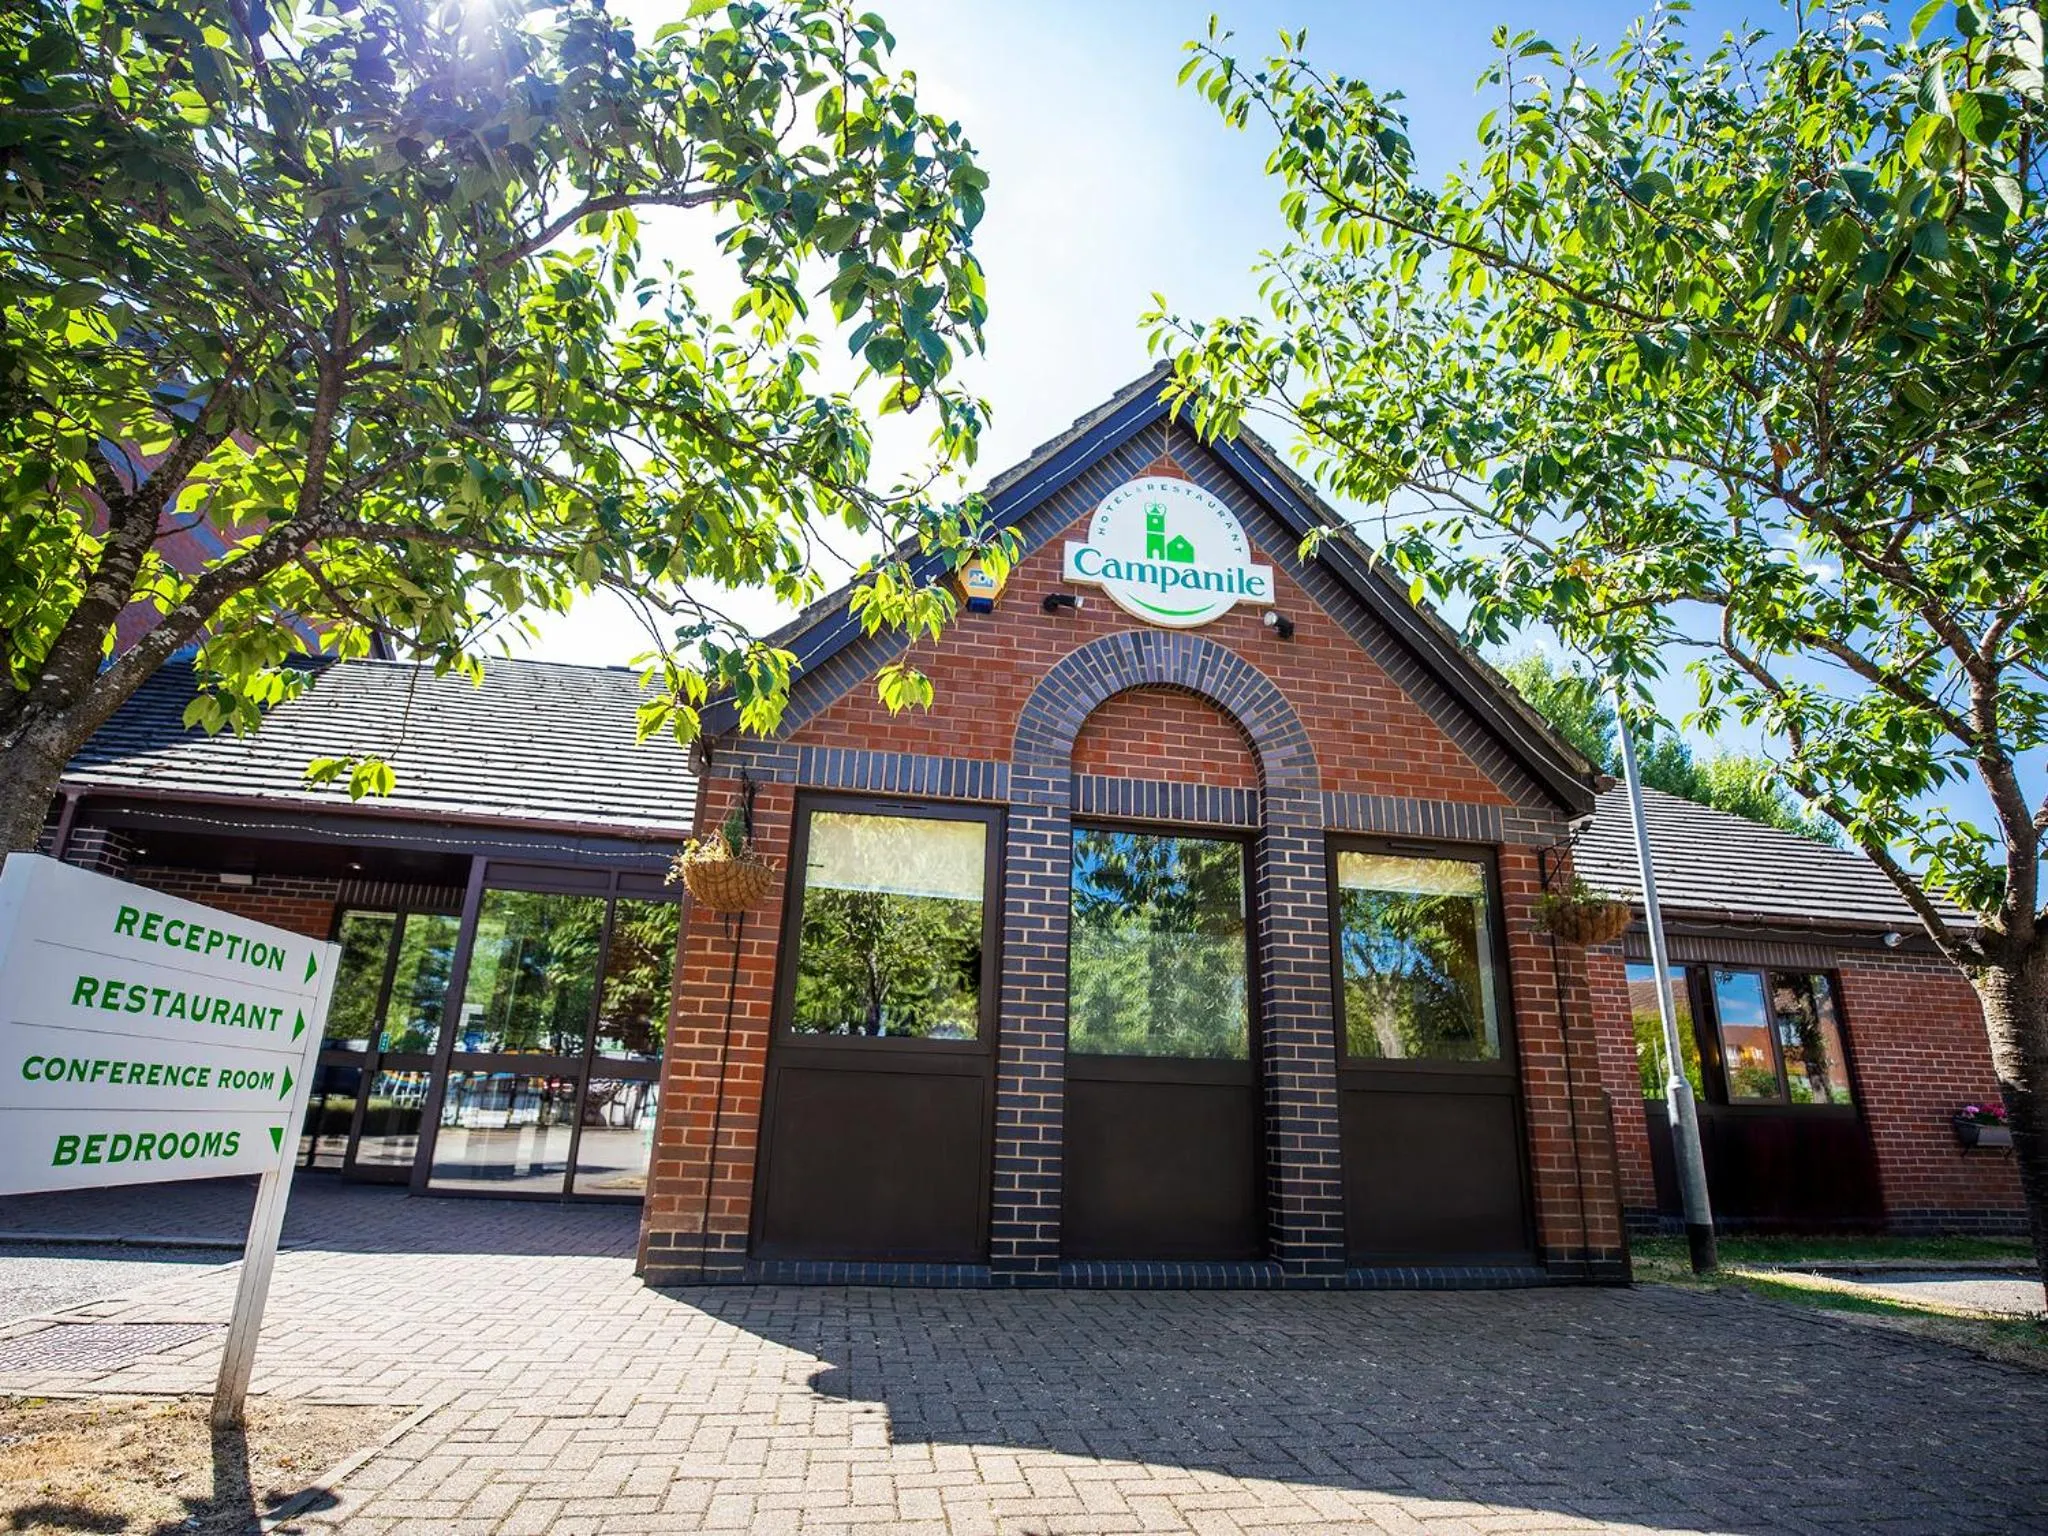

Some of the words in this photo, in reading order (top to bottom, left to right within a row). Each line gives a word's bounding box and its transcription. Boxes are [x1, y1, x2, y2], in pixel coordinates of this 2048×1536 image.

[1097, 490, 1132, 536] HOTEL
[1146, 483, 1242, 553] RESTAURANT
[1073, 547, 1266, 597] Campanile
[113, 905, 286, 972] RECEPTION
[71, 976, 283, 1032] RESTAURANT
[22, 1056, 210, 1088] CONFERENCE
[217, 1069, 274, 1090] ROOM
[51, 1131, 241, 1167] BEDROOMS
